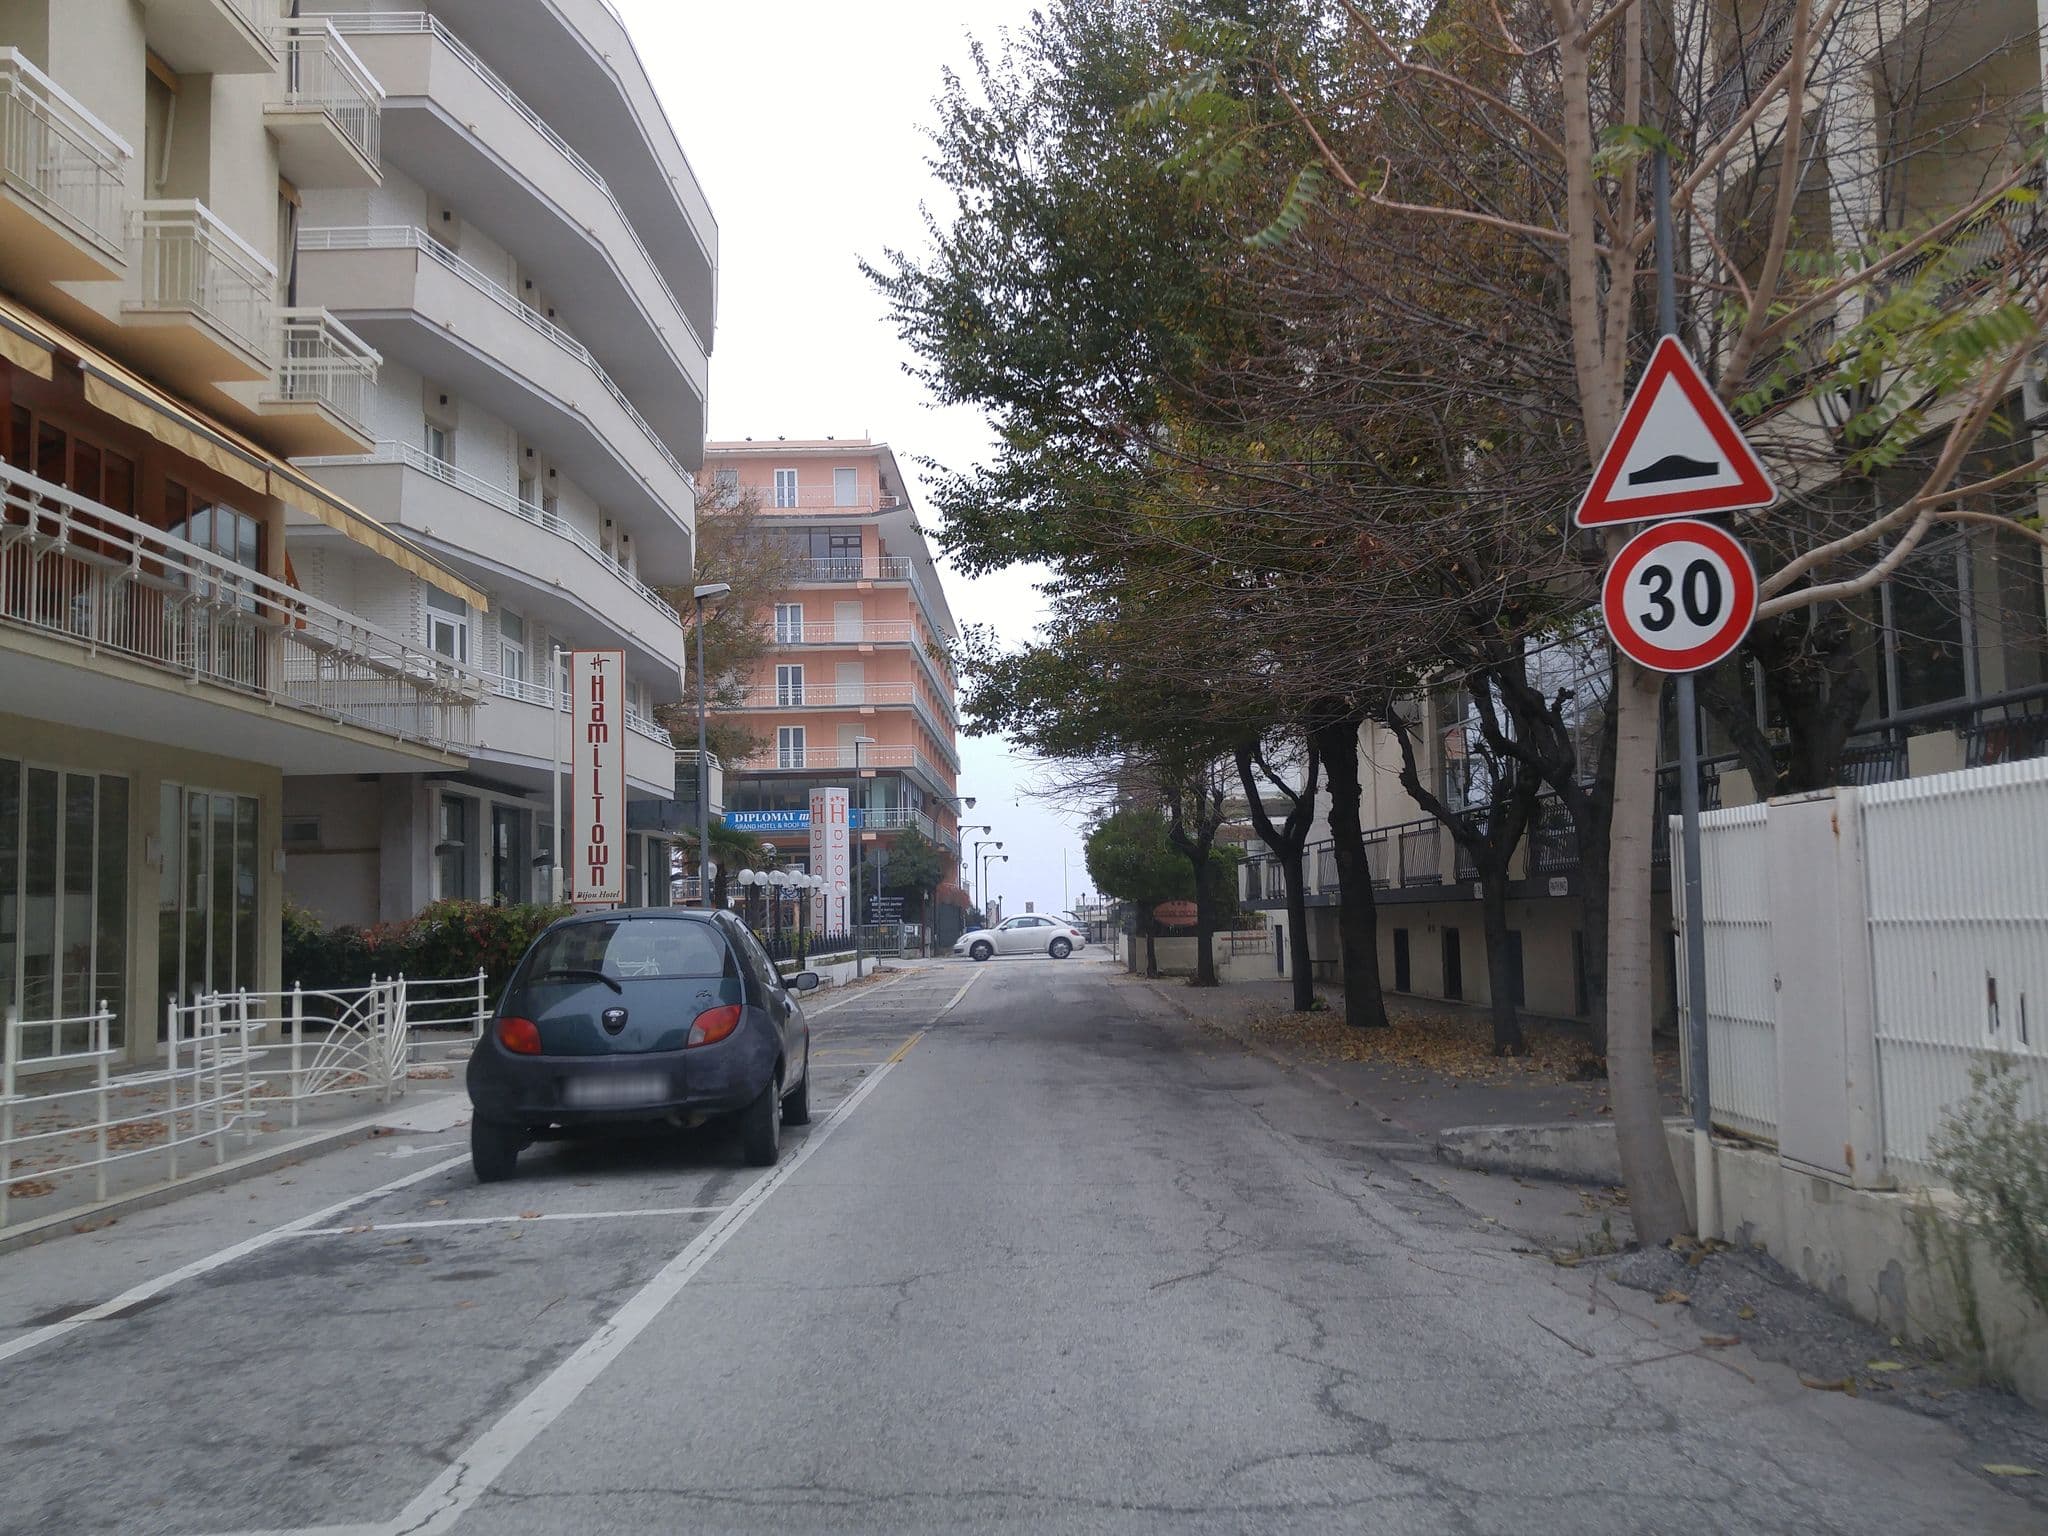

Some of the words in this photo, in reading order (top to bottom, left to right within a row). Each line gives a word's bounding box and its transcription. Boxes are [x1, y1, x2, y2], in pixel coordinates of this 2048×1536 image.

[1639, 559, 1722, 631] 30
[735, 812, 795, 822] DIPLOMAT
[599, 890, 620, 898] Hotel
[813, 829, 823, 935] araosta
